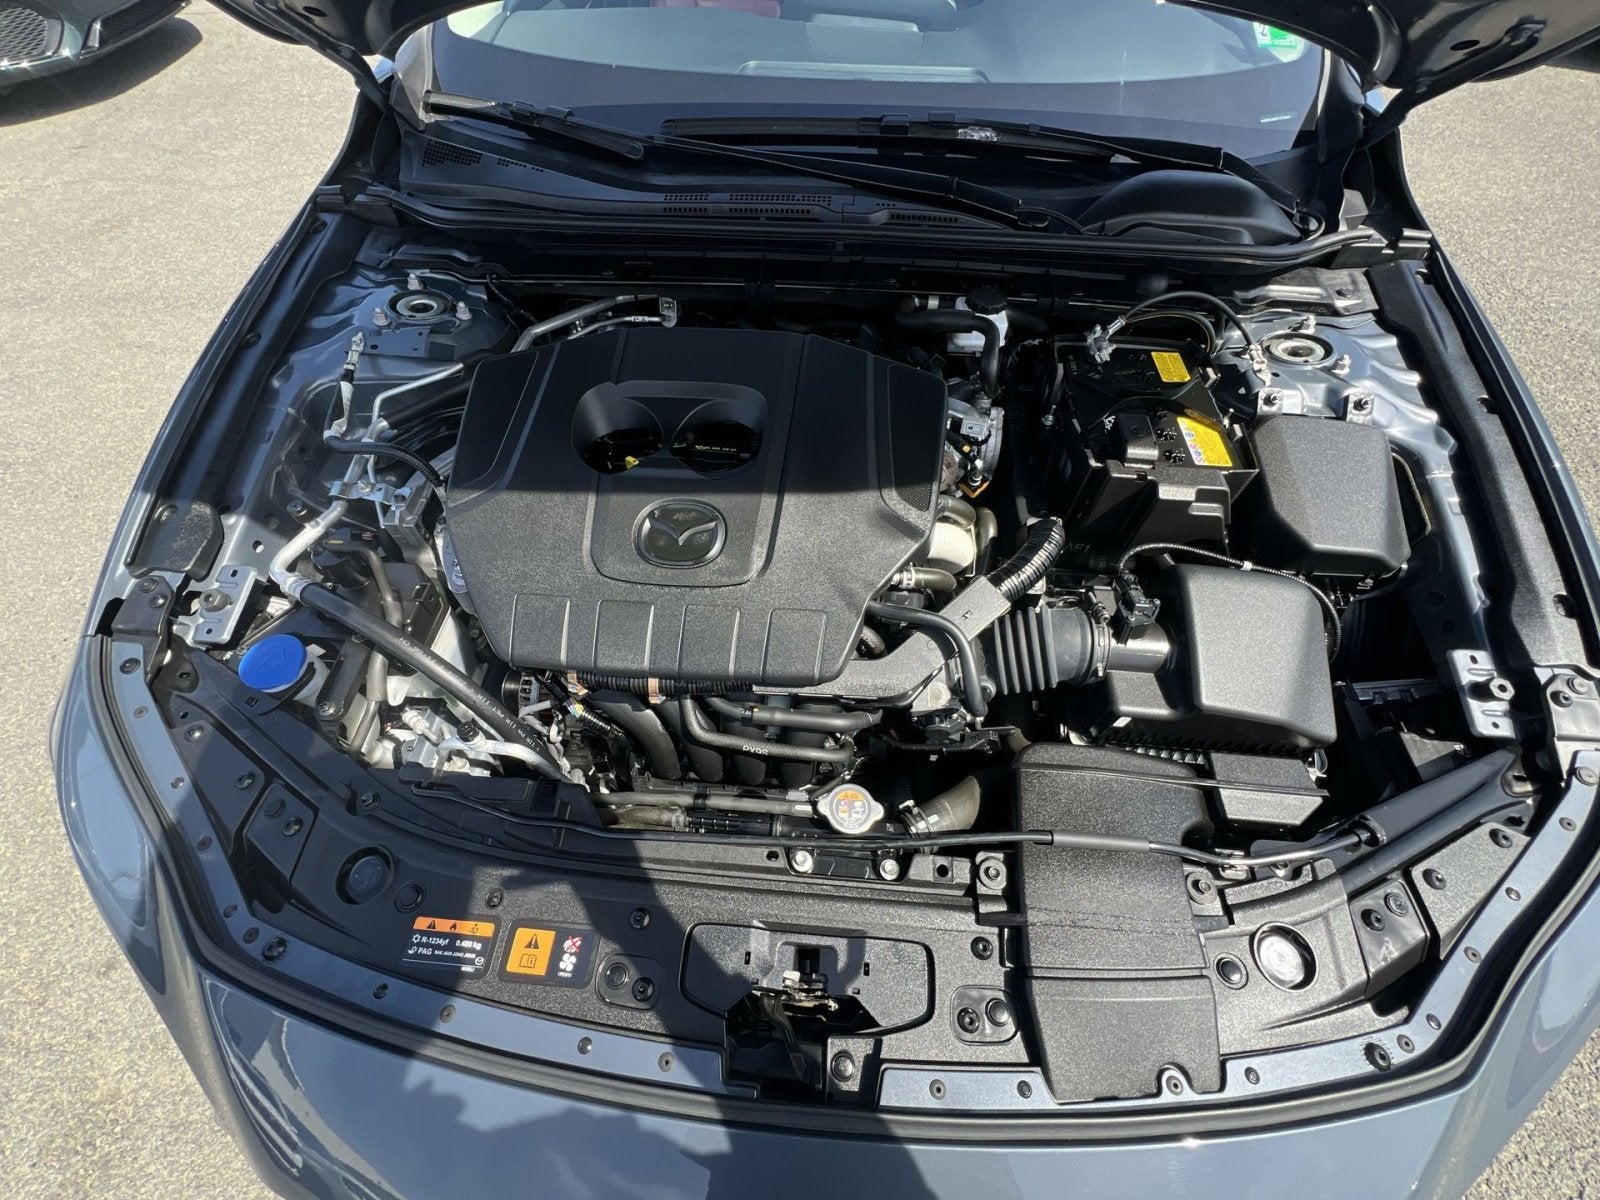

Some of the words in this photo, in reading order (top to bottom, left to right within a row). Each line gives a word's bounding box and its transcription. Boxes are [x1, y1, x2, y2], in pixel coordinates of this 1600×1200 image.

[421, 936, 450, 947] R-1234yf
[472, 941, 482, 951] kg
[417, 947, 433, 955] PAG
